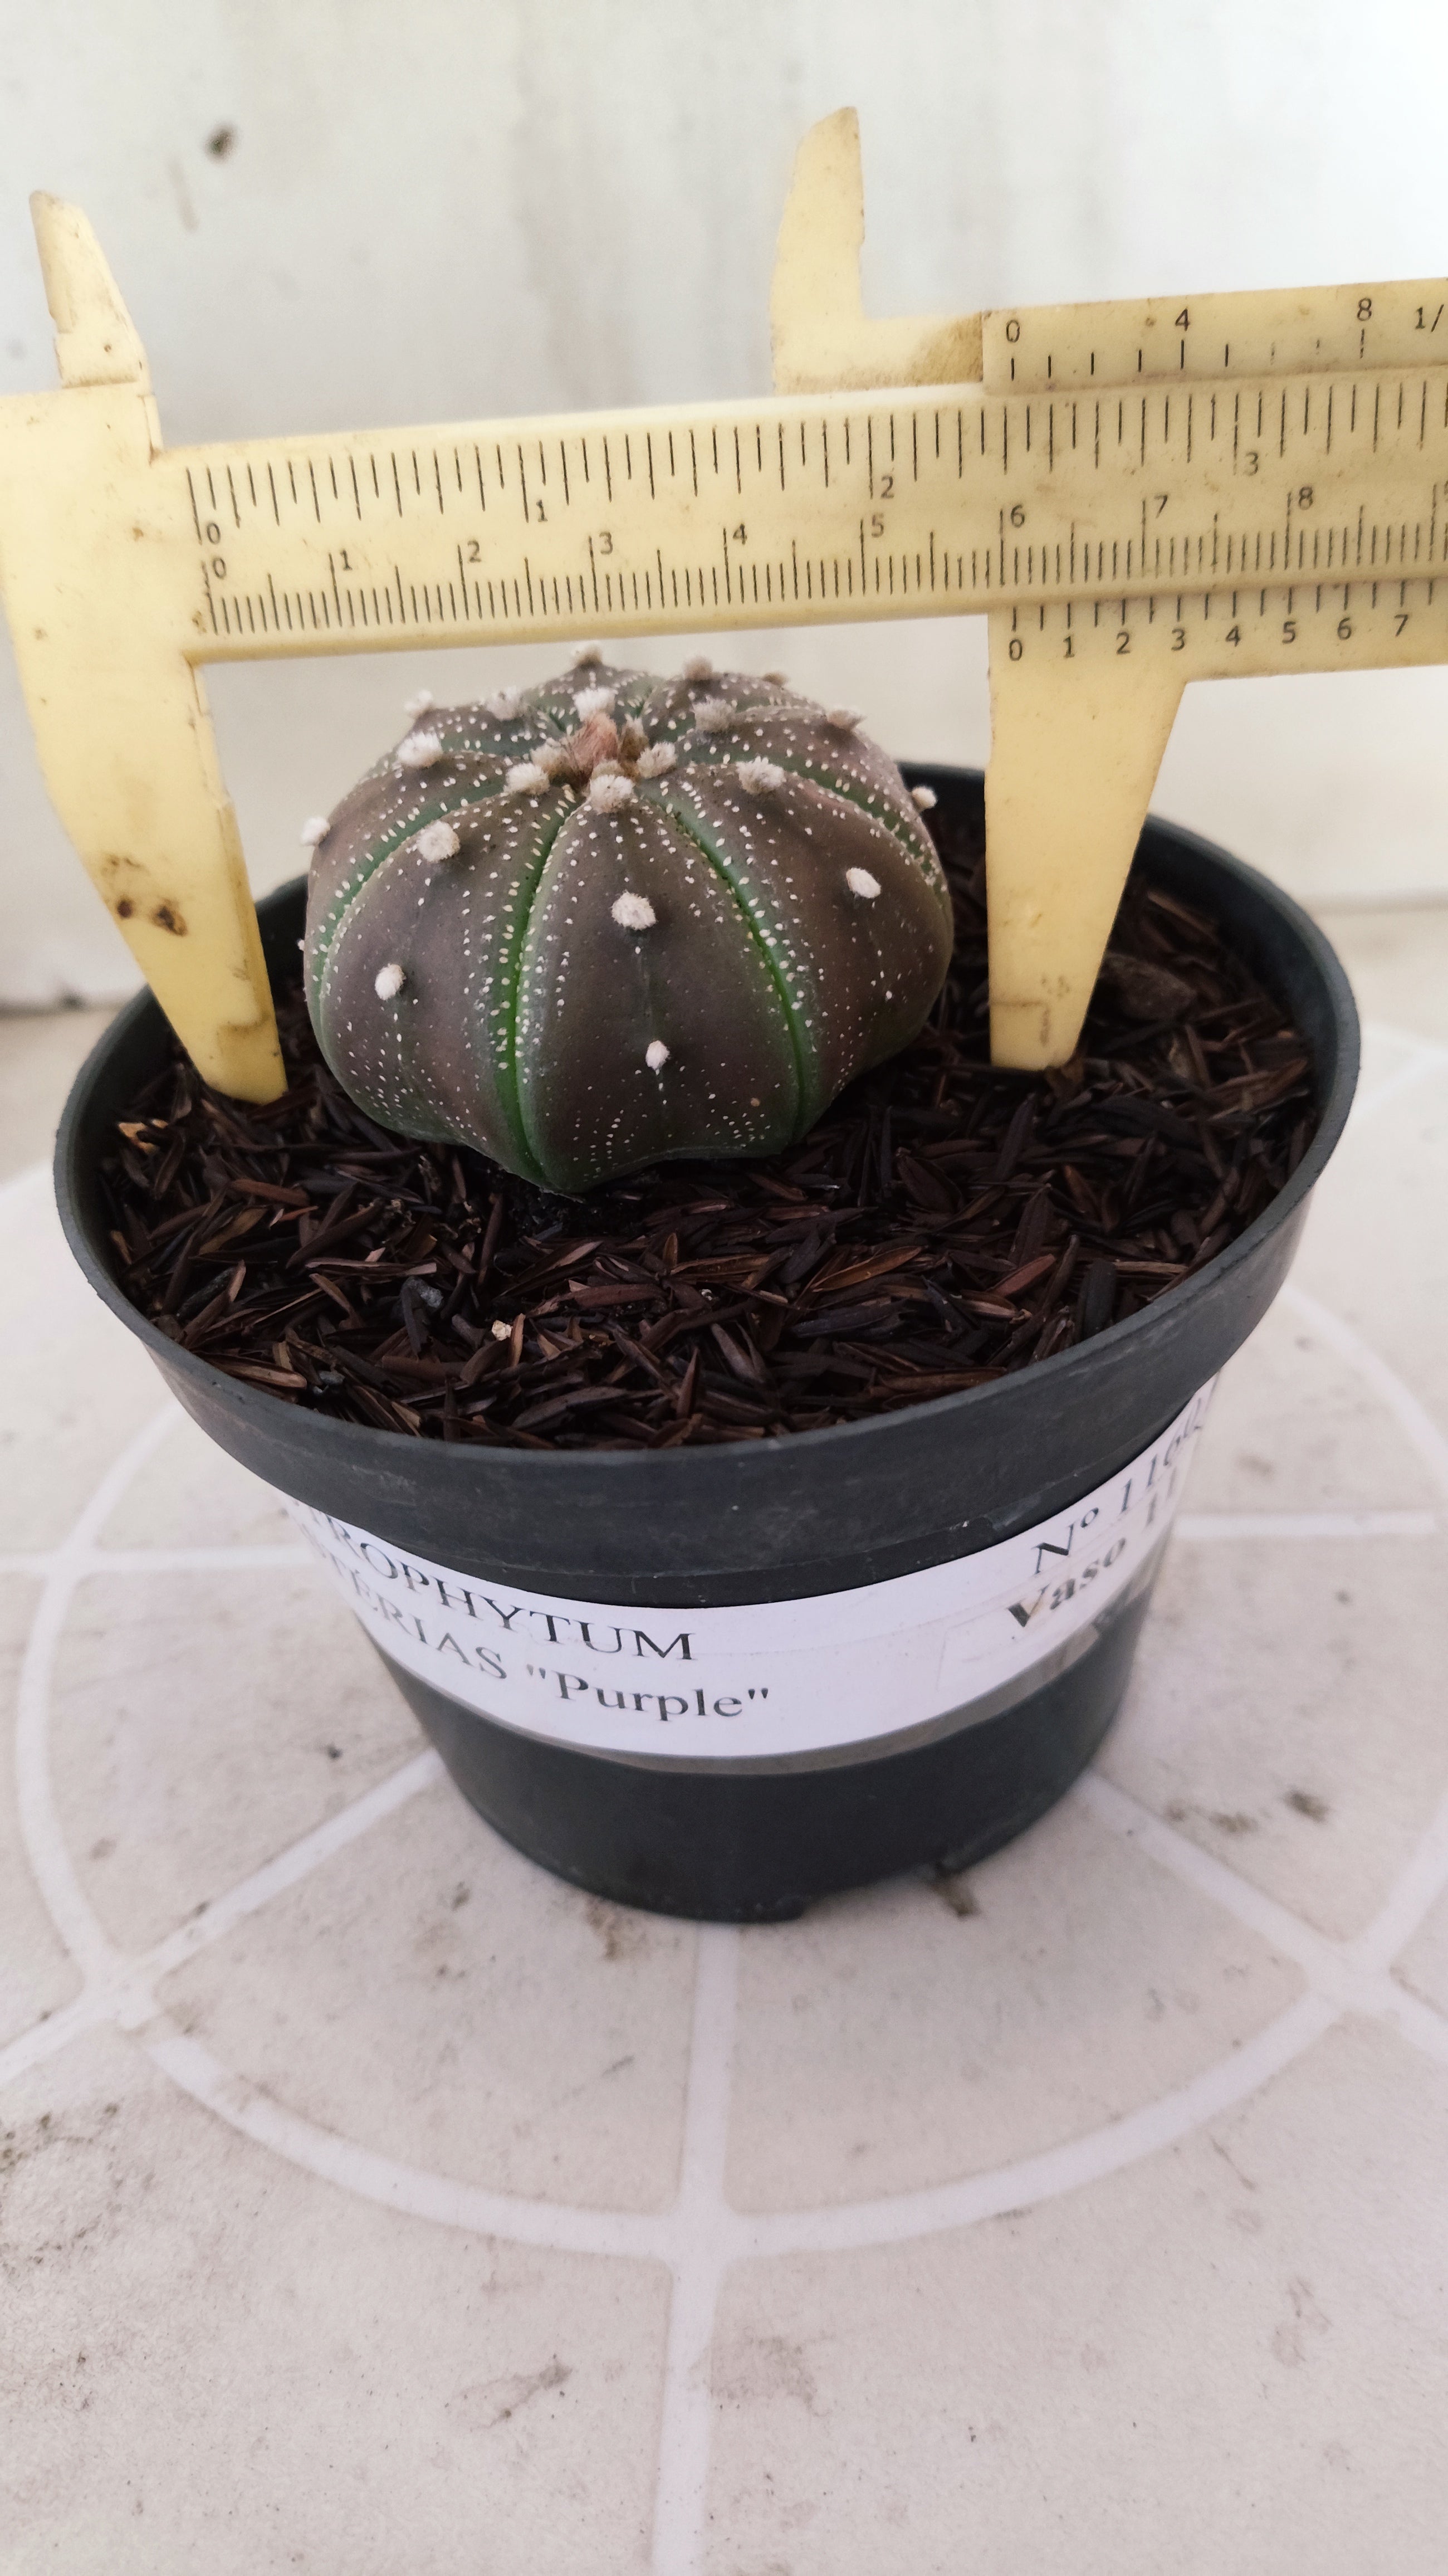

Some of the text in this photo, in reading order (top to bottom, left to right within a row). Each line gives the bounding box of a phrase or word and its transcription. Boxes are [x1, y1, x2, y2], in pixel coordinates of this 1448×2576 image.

[1006, 320, 1020, 343] 0
[1174, 308, 1191, 330] 4
[1356, 297, 1372, 321] 8
[206, 451, 1259, 544] 0 1 2 3
[212, 485, 1314, 579] 0 1 2 3 4 5 6 7 8
[1009, 613, 1410, 661] 0 1 2 3 4 5 6 7
[305, 1503, 696, 1661] ROPHYTUM
[1007, 1538, 1126, 1627] Vaso
[525, 1663, 770, 1723] "Purple"
